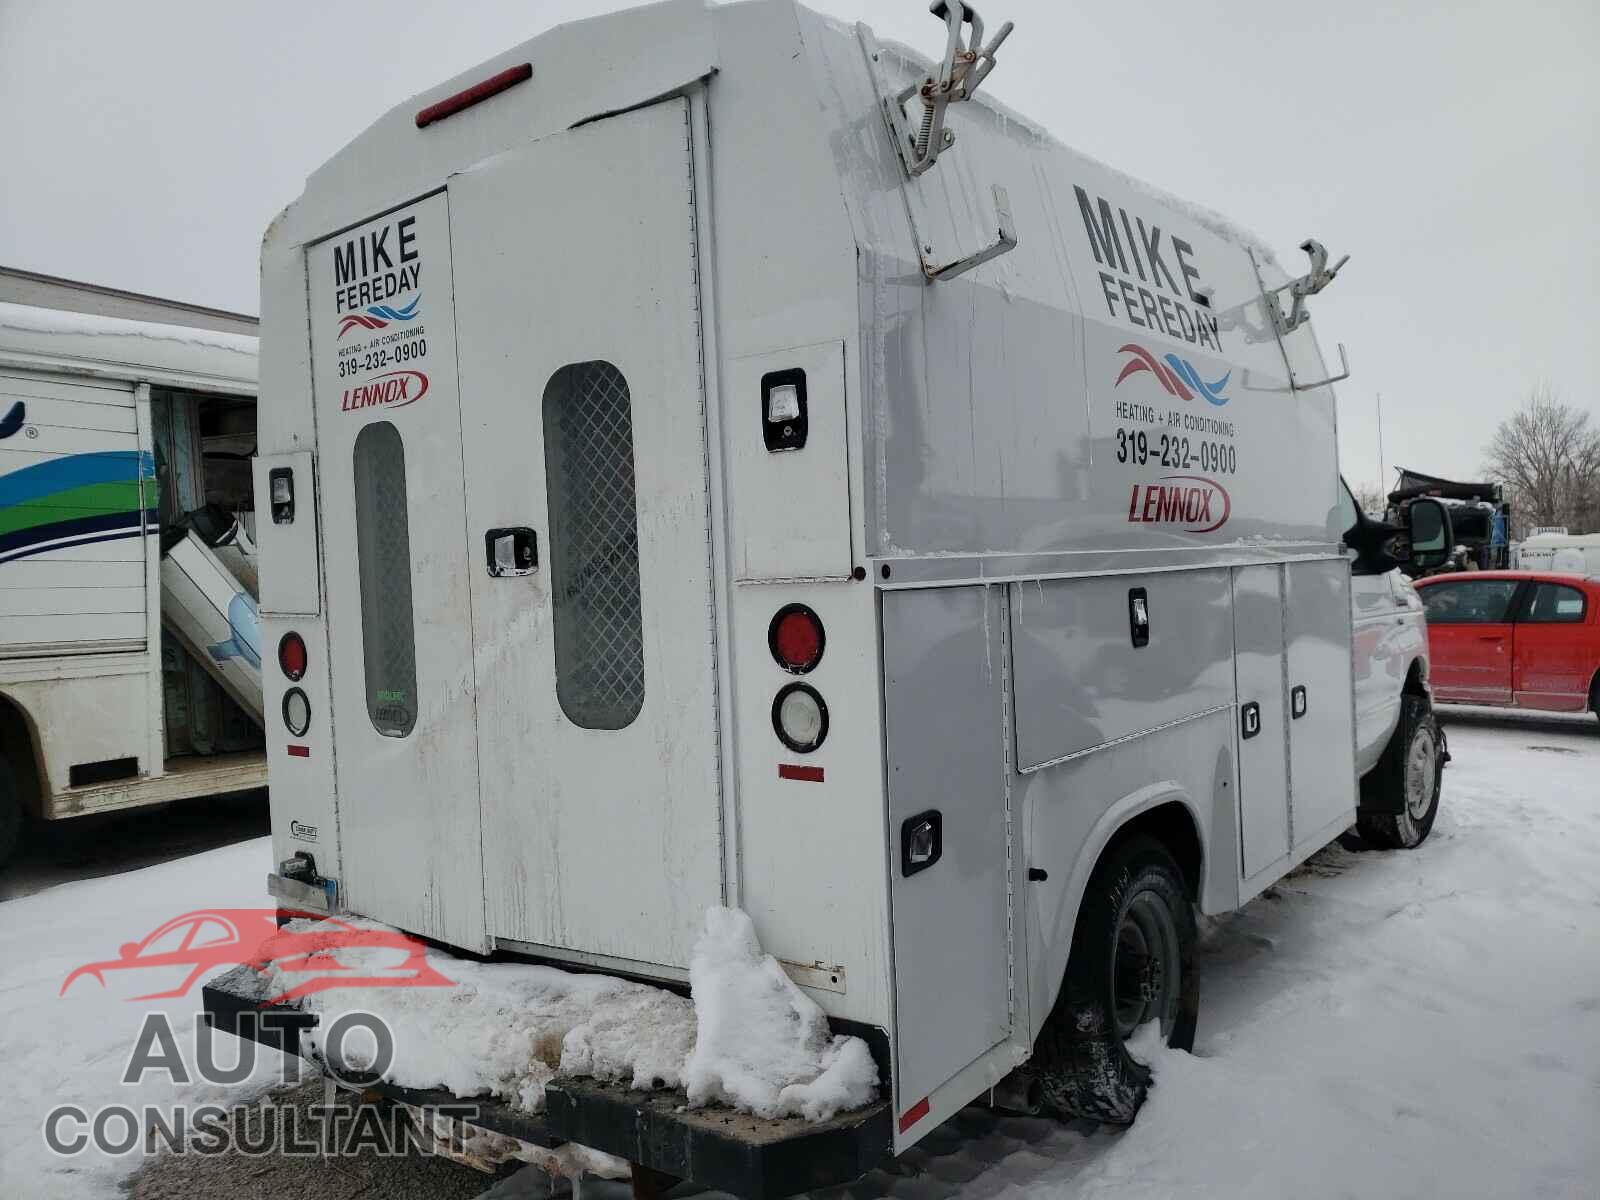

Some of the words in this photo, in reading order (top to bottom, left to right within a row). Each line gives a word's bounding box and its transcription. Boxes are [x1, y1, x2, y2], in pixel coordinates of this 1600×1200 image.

[333, 215, 419, 286] MIKE
[1072, 183, 1211, 308] MIKE
[336, 262, 421, 314] FEREDAY
[1098, 271, 1222, 352] FEREDAY
[338, 343, 361, 357] HEATING
[369, 337, 380, 348] AIR
[381, 325, 424, 345] CONDITIONING
[338, 338, 426, 377] 319-232-0900
[341, 376, 410, 412] LENNOX
[1116, 400, 1154, 423] HEATING
[1168, 411, 1180, 428] AIR
[1184, 414, 1234, 437] CONDITIONING
[1116, 427, 1236, 474] 319-232-0900
[1128, 485, 1214, 522] LENNOX
